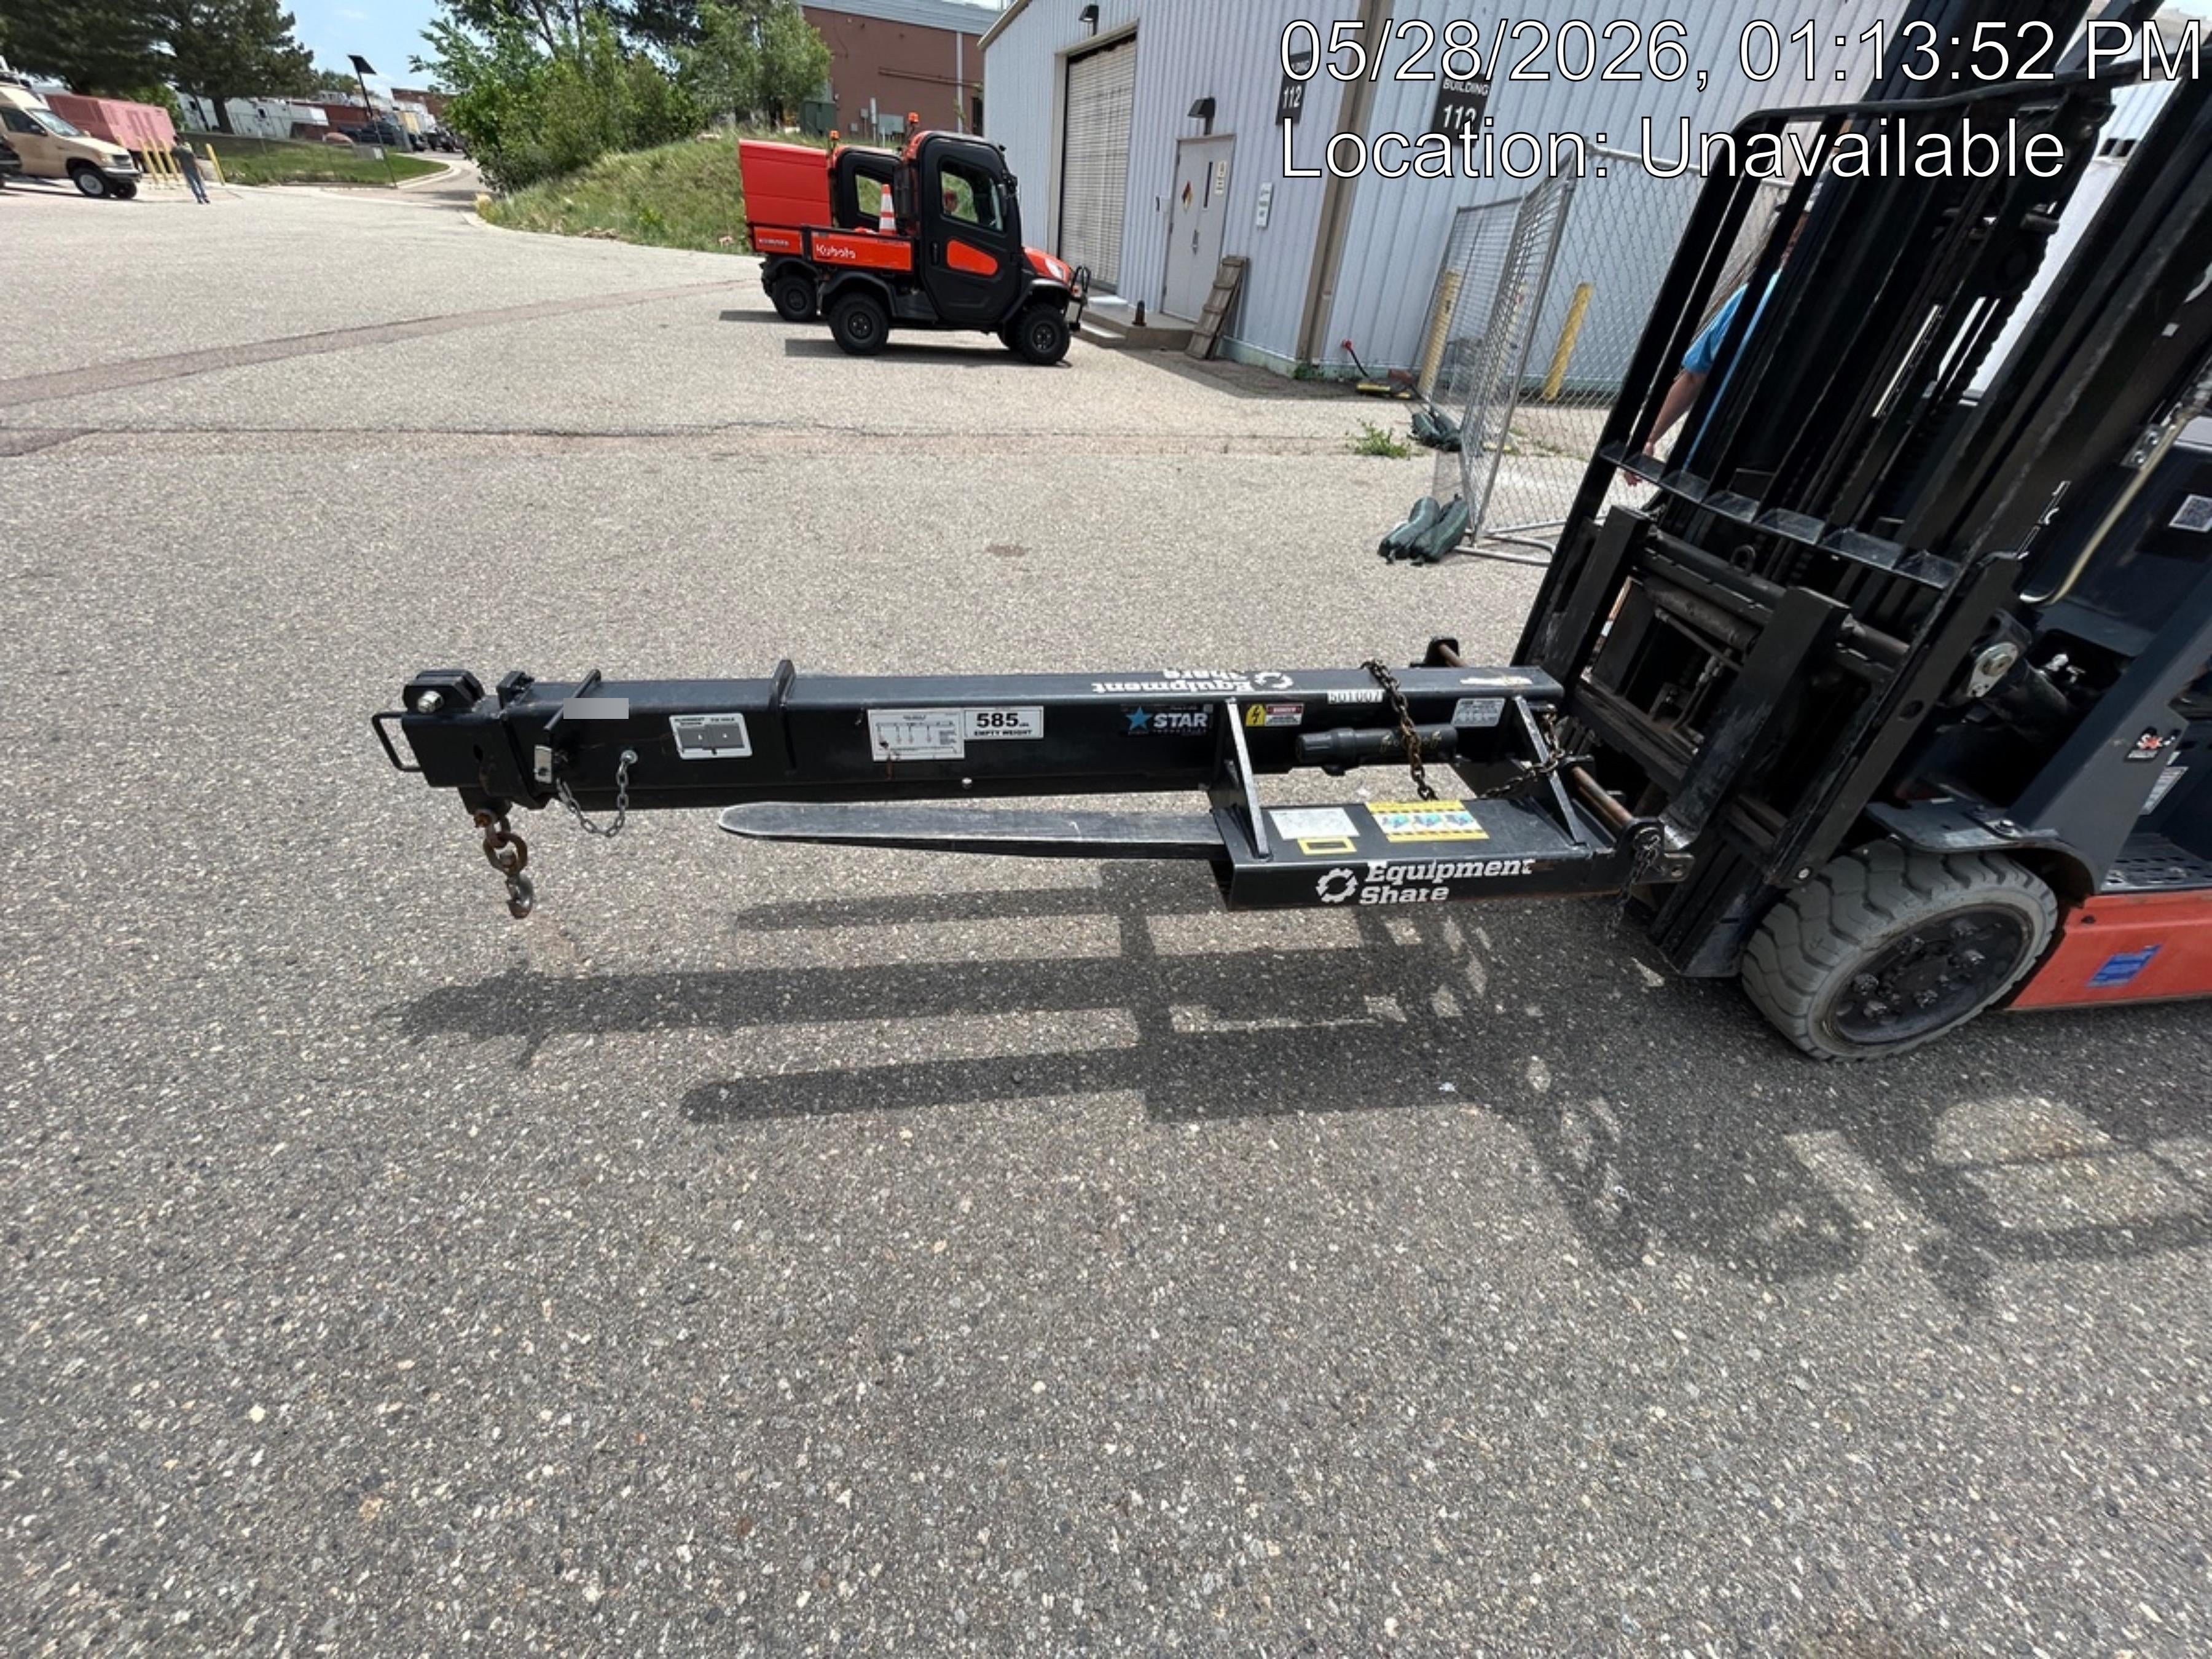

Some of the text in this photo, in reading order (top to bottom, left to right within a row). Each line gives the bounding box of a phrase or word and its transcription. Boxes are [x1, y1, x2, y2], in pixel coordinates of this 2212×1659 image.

[1282, 85, 1302, 109] 112
[816, 244, 856, 259] Kubota
[976, 713, 1019, 728] 585
[1153, 712, 1208, 728] STAR
[1365, 858, 1536, 885] Equipment
[1359, 885, 1449, 905] Share
